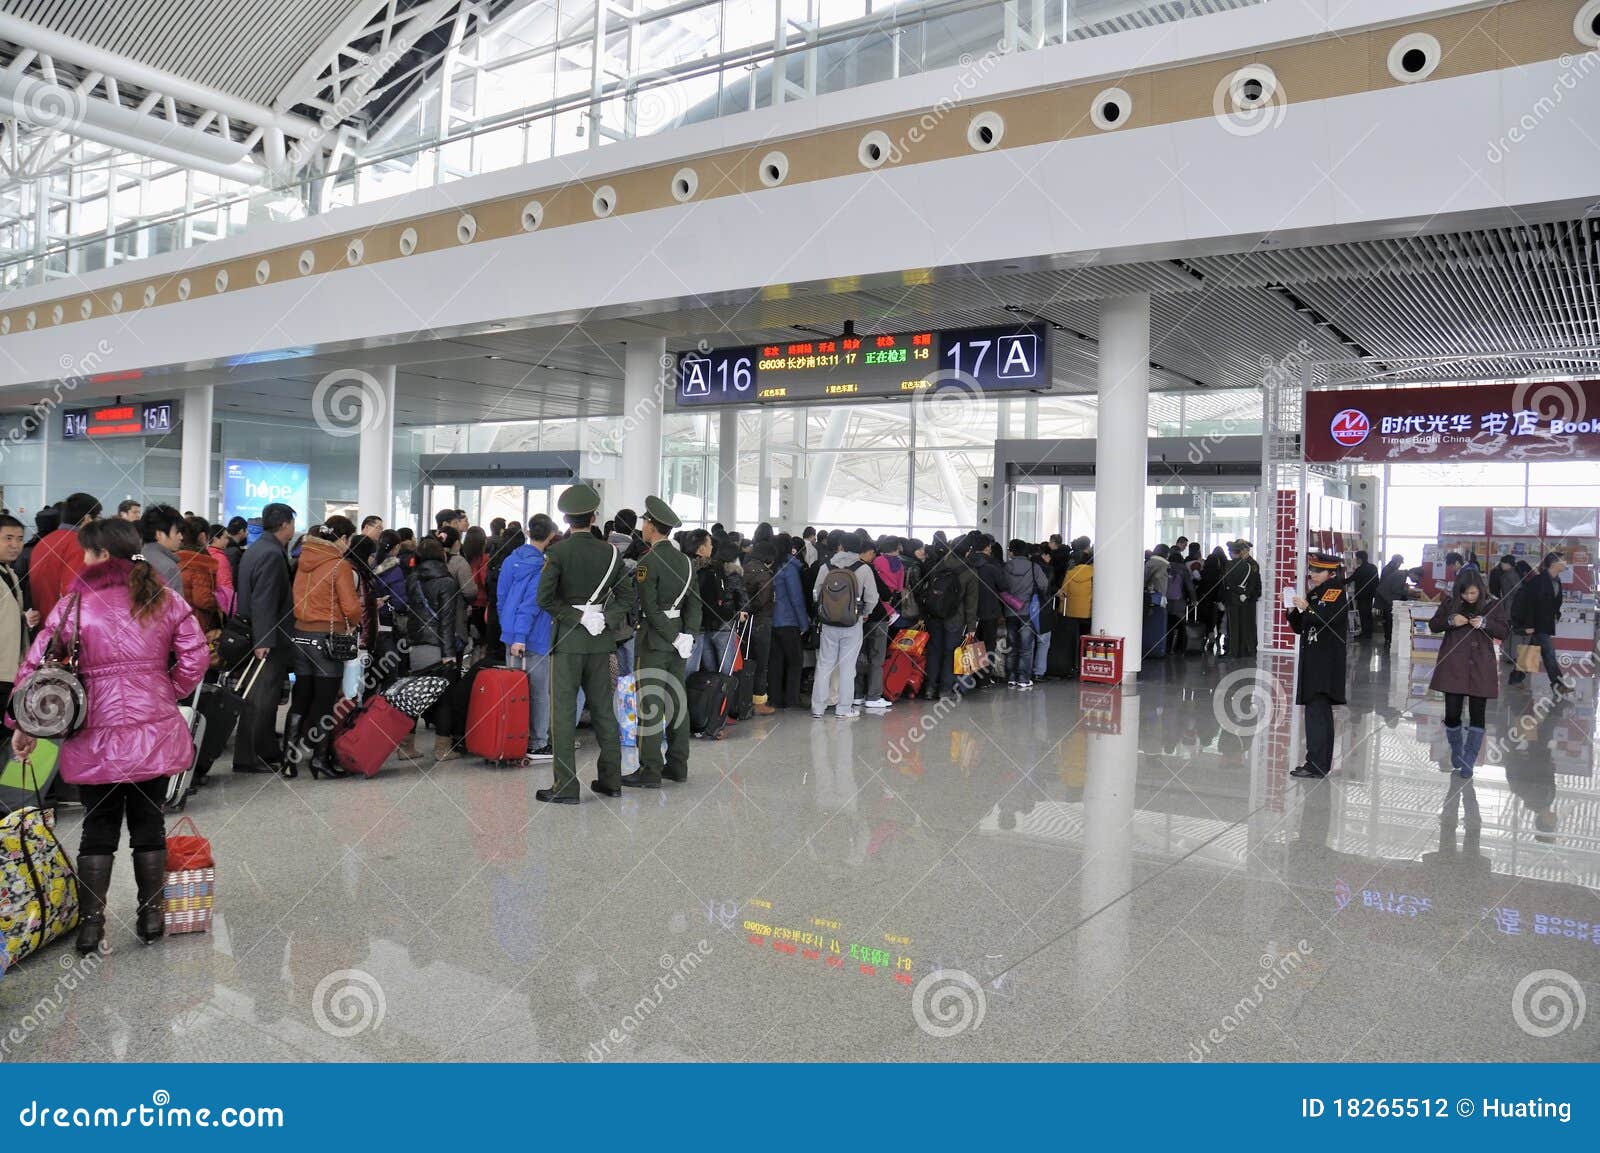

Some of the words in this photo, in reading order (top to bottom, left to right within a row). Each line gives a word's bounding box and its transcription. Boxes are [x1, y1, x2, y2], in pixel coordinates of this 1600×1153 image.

[758, 358, 786, 371] G6036
[787, 355, 816, 369] 长沙南
[816, 354, 839, 368] 13:11
[845, 353, 857, 365] 17
[913, 348, 930, 360] 1-8
[947, 340, 992, 379] 17
[1002, 340, 1031, 374] A
[687, 363, 707, 392] A
[717, 358, 751, 392] 16
[65, 416, 74, 434] A
[75, 414, 87, 435] 14
[143, 408, 157, 429] 15
[159, 407, 168, 428] A
[1381, 414, 1472, 434] 时代光华
[1480, 410, 1539, 436] 书店
[1442, 434, 1471, 444] China
